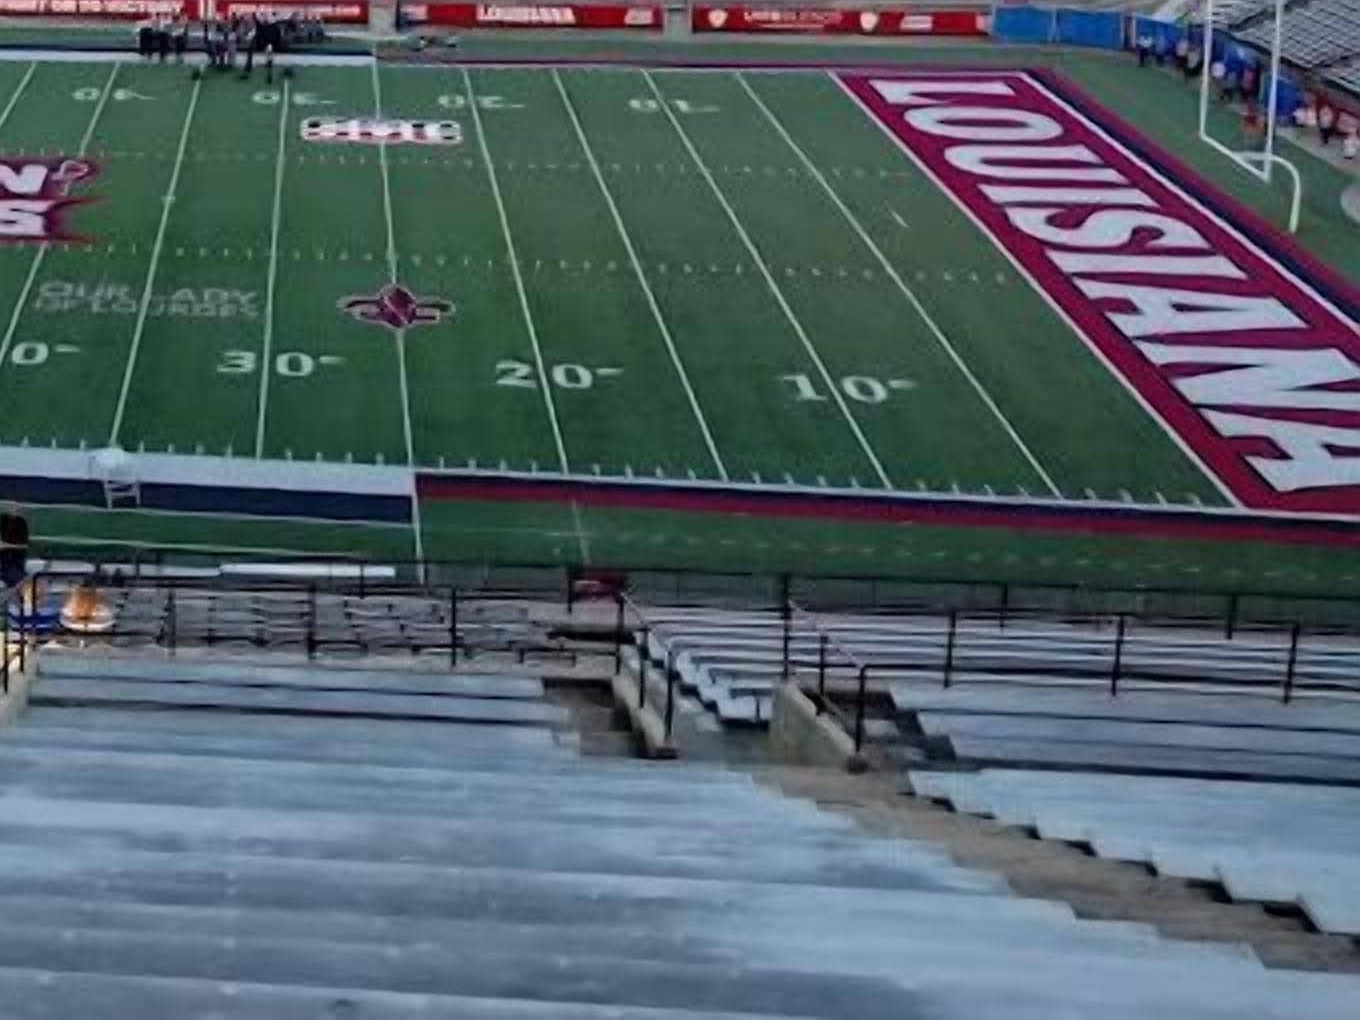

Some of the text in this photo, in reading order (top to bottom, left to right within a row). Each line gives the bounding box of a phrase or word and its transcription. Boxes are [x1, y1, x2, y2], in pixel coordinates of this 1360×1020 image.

[216, 350, 315, 376] 30
[495, 359, 593, 388] 20
[784, 373, 889, 403] 10
